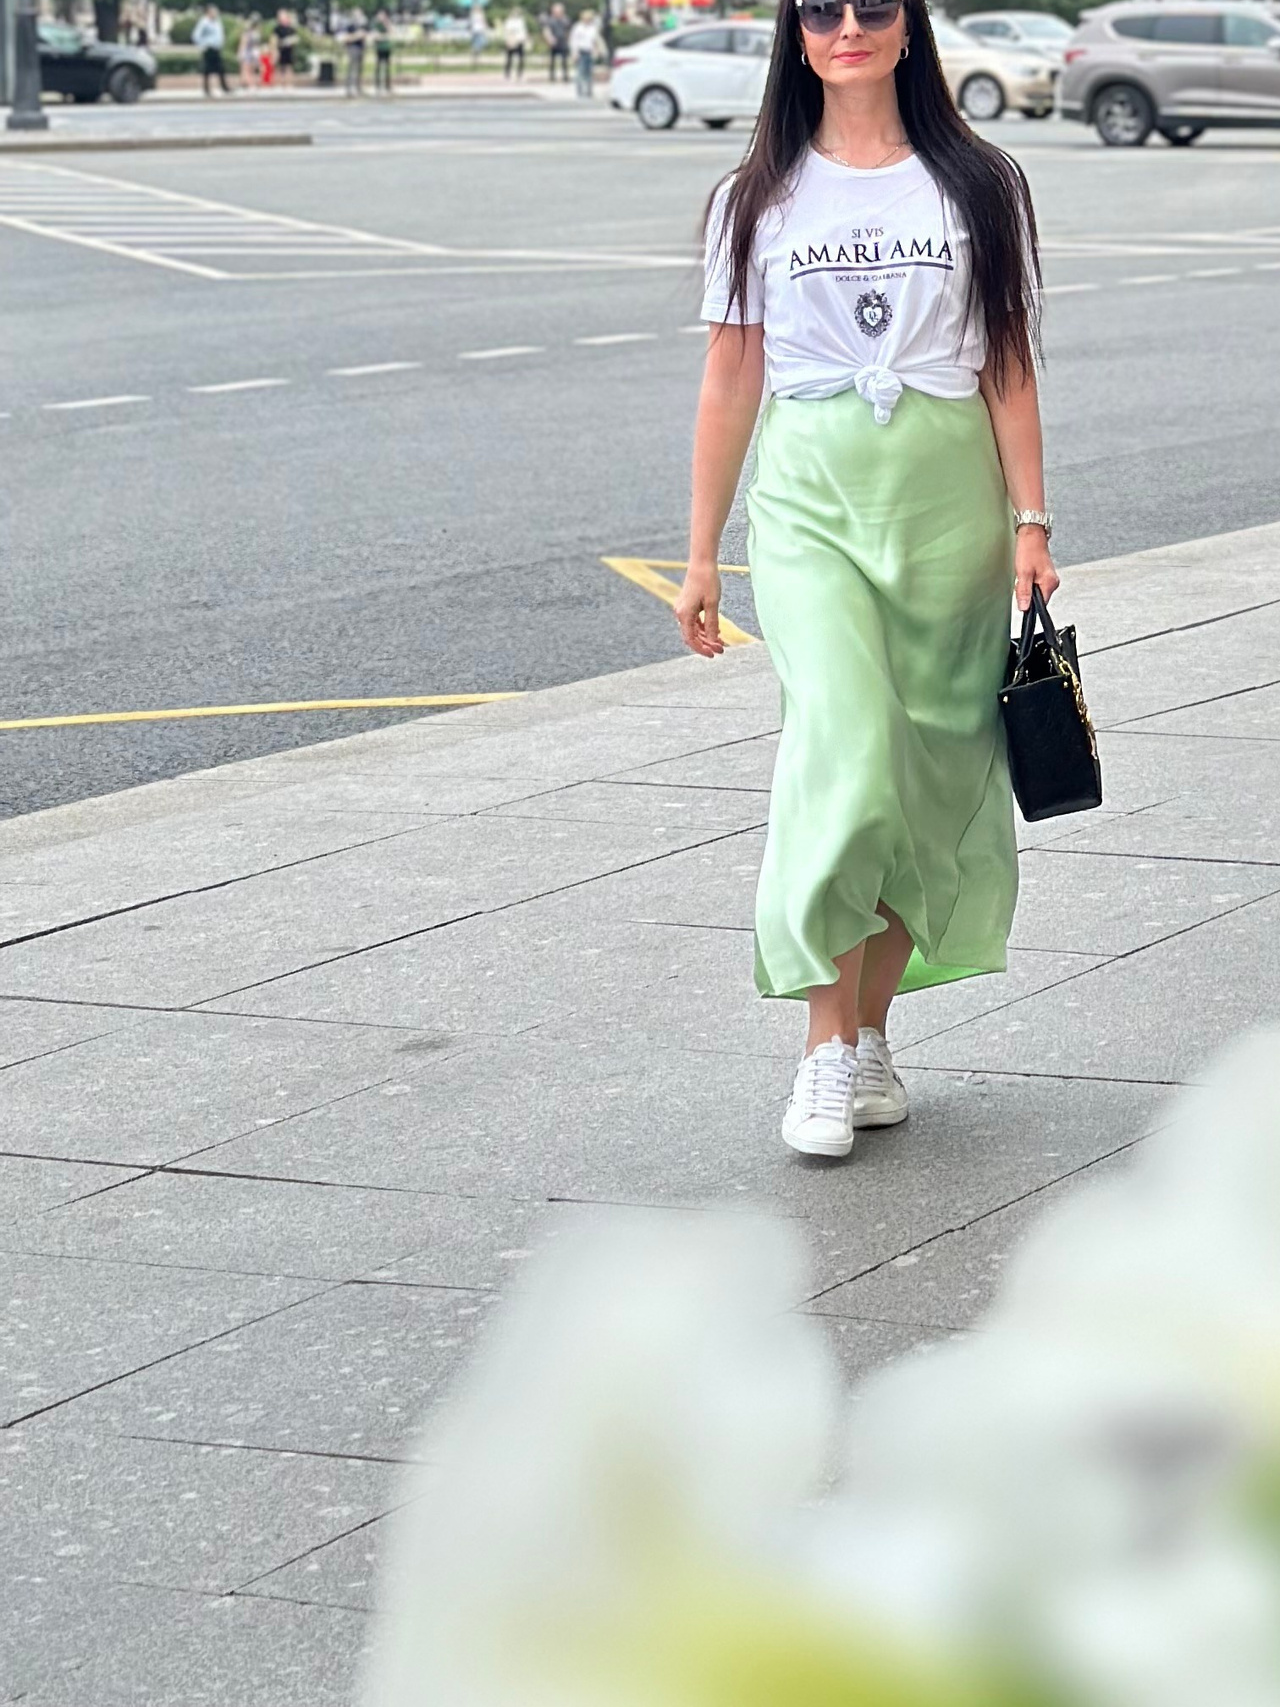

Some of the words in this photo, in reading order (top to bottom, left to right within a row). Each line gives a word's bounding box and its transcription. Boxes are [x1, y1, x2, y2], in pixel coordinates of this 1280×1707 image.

[851, 228, 861, 239] SI
[865, 227, 884, 238] VIS
[789, 241, 882, 271] AMARI
[890, 237, 954, 262] AMA
